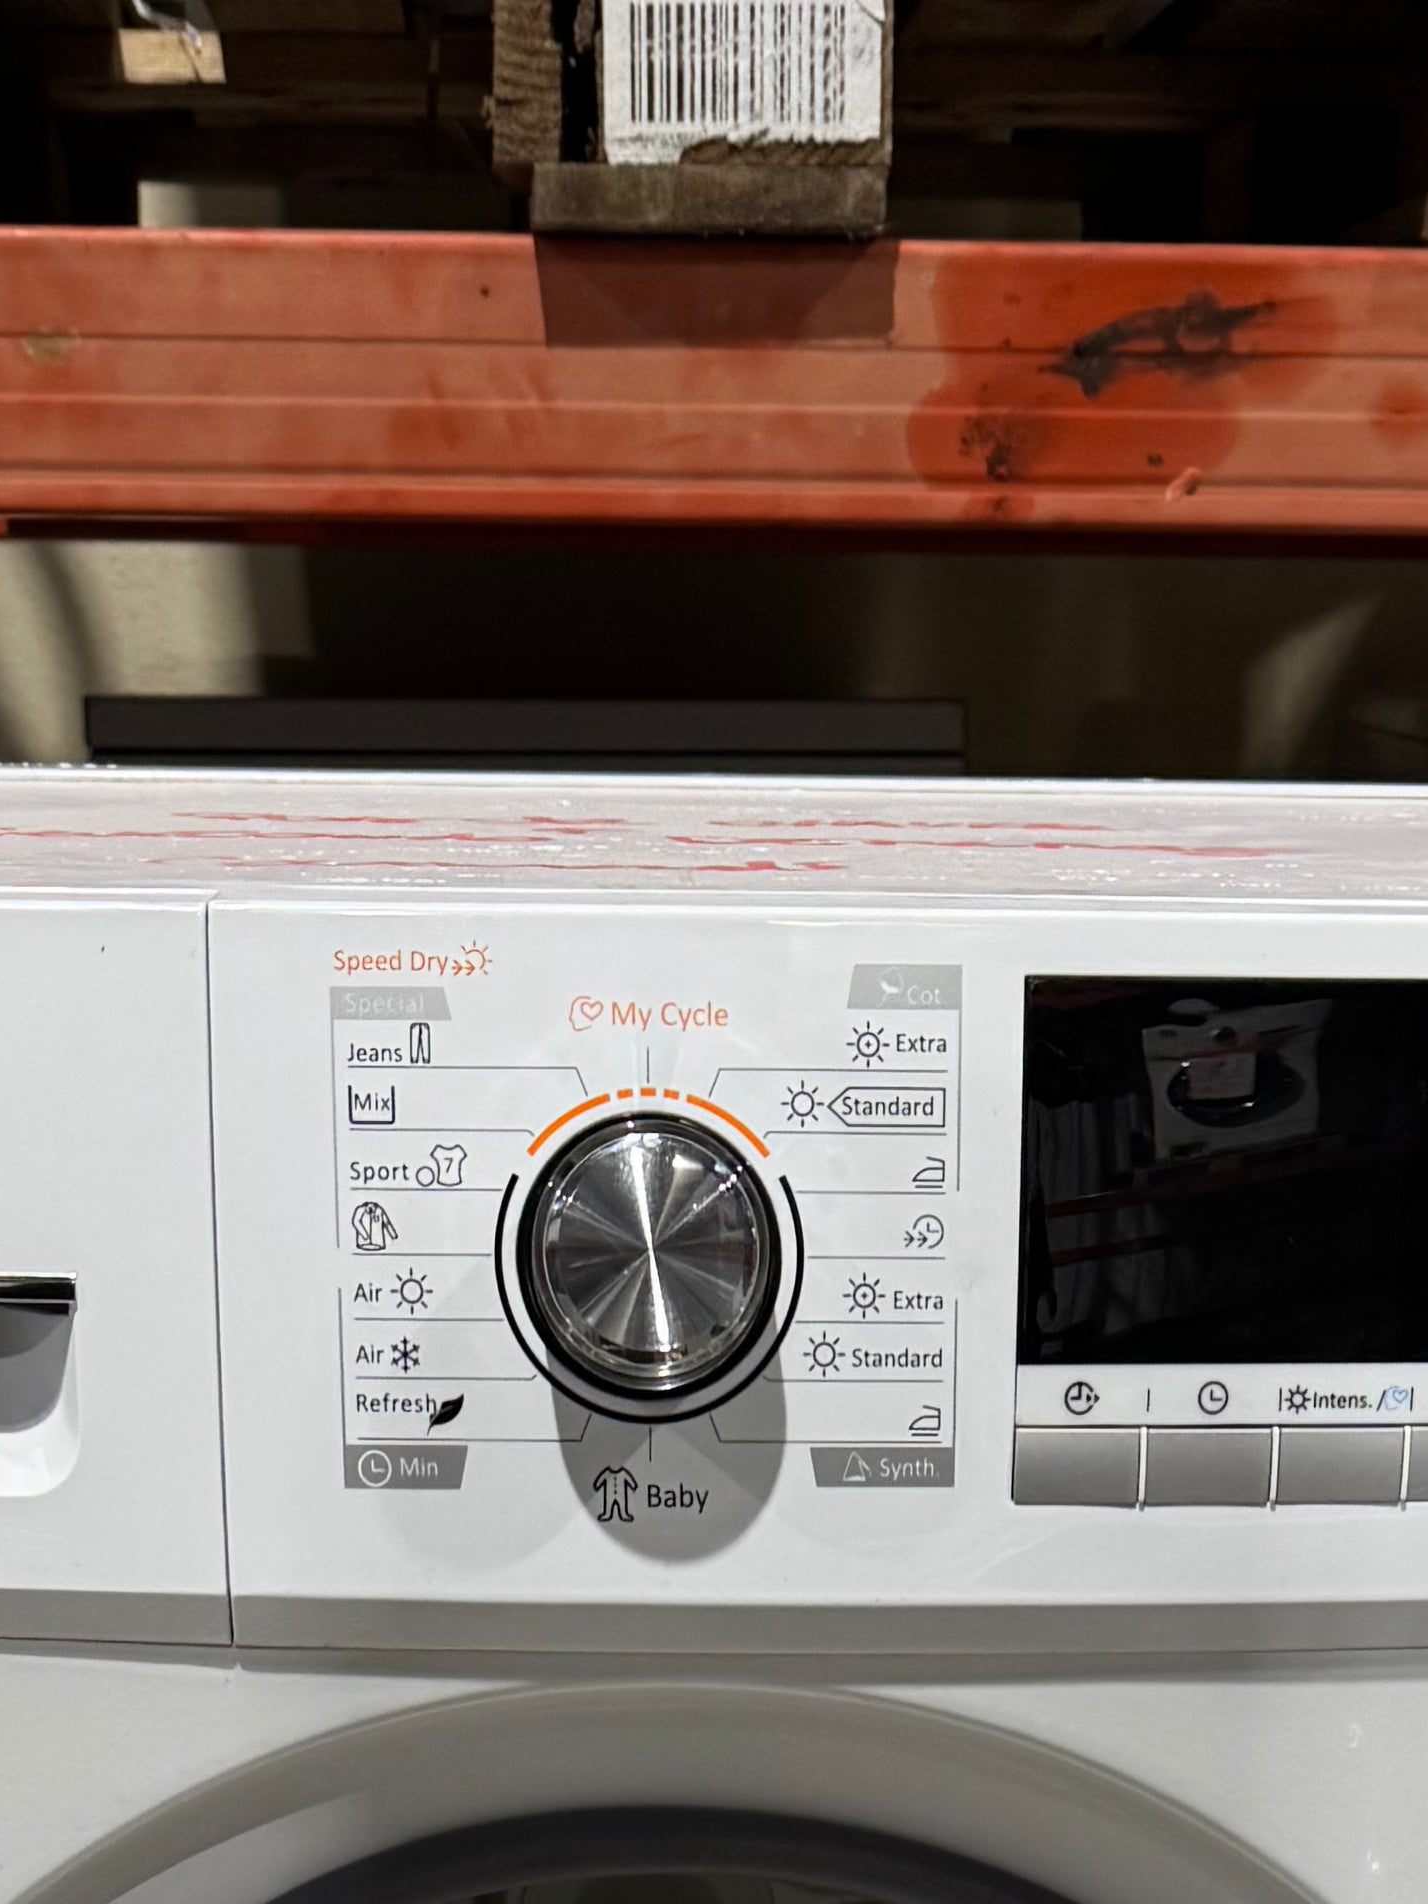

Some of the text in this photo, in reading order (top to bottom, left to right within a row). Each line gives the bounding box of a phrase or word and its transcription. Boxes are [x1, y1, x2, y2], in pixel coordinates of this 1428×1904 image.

[333, 949, 449, 977] Speed Dry
[345, 993, 425, 1016] Special
[612, 1001, 729, 1032] My Cycle
[347, 1043, 403, 1064] Jeans
[896, 1033, 948, 1053] Extra
[354, 1094, 391, 1112] Mix
[841, 1096, 935, 1117] Standard
[349, 1161, 410, 1185] Sport
[354, 1283, 383, 1303] Air
[893, 1291, 944, 1310] Extra
[355, 1346, 384, 1365] Air
[852, 1348, 943, 1369] Standard
[356, 1393, 436, 1414] Refresh
[1313, 1391, 1373, 1408] Intens.
[400, 1456, 439, 1478] Min
[646, 1483, 709, 1514] Baby
